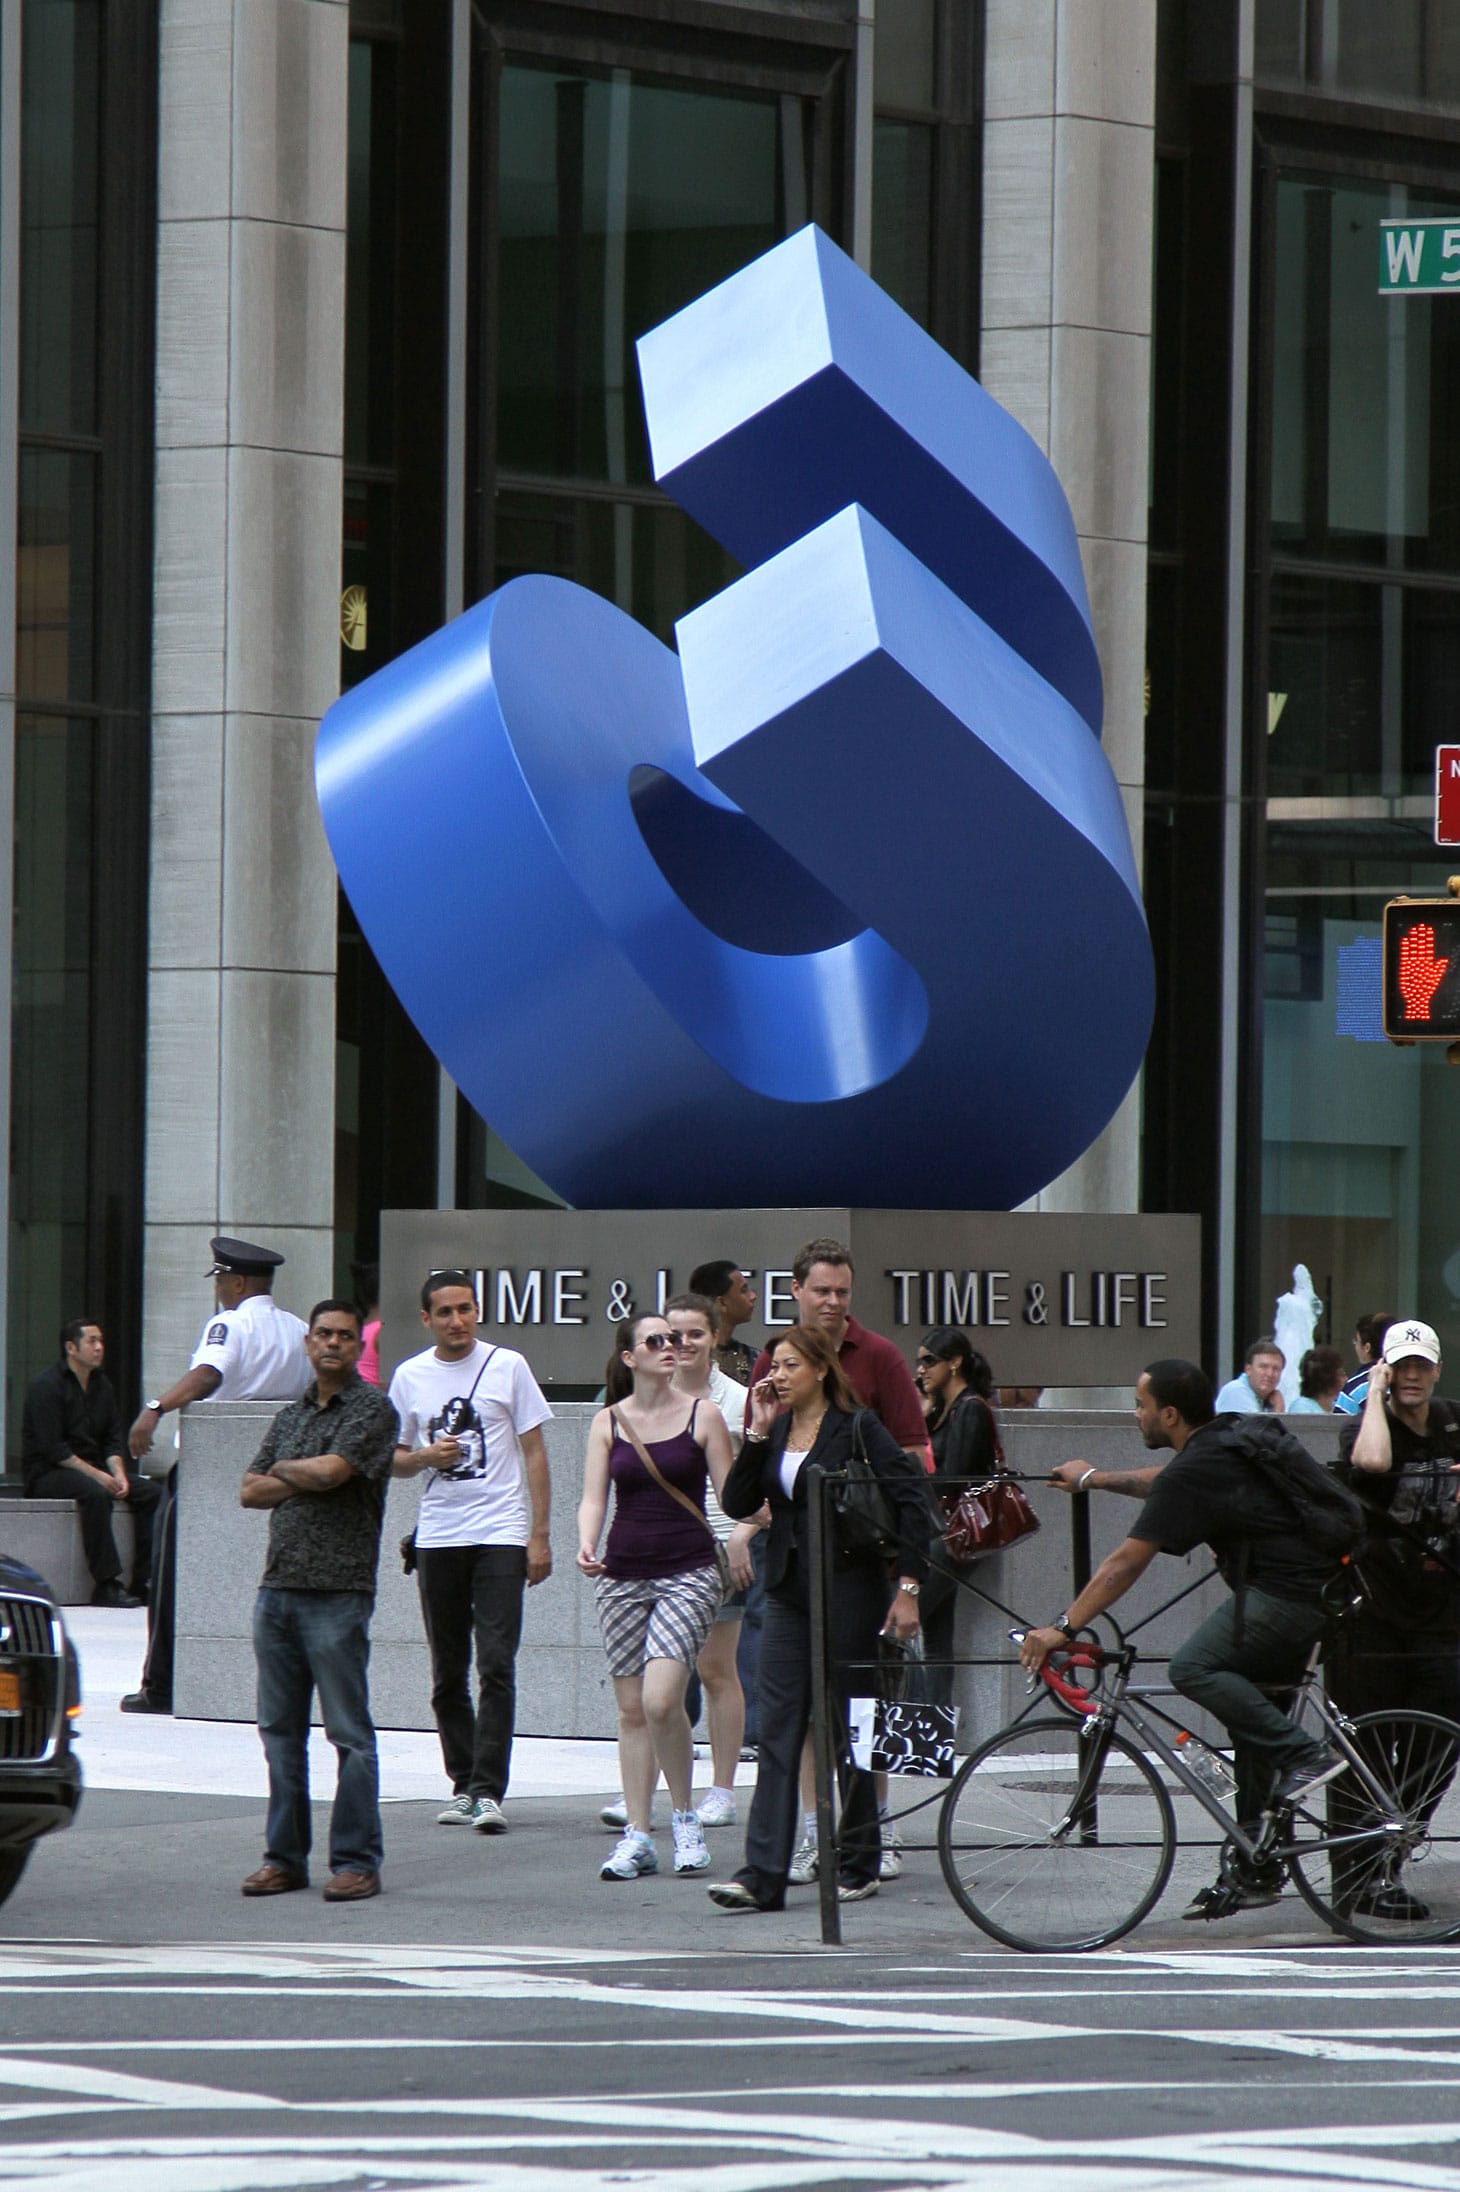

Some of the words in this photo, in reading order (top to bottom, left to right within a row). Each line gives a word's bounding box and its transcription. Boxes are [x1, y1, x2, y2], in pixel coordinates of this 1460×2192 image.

[1386, 230, 1425, 283] W
[430, 1269, 584, 1324] IME
[606, 1279, 631, 1323] &
[889, 1270, 1011, 1326] TIME
[1026, 1281, 1049, 1326] &
[1066, 1272, 1168, 1328] LIFE
